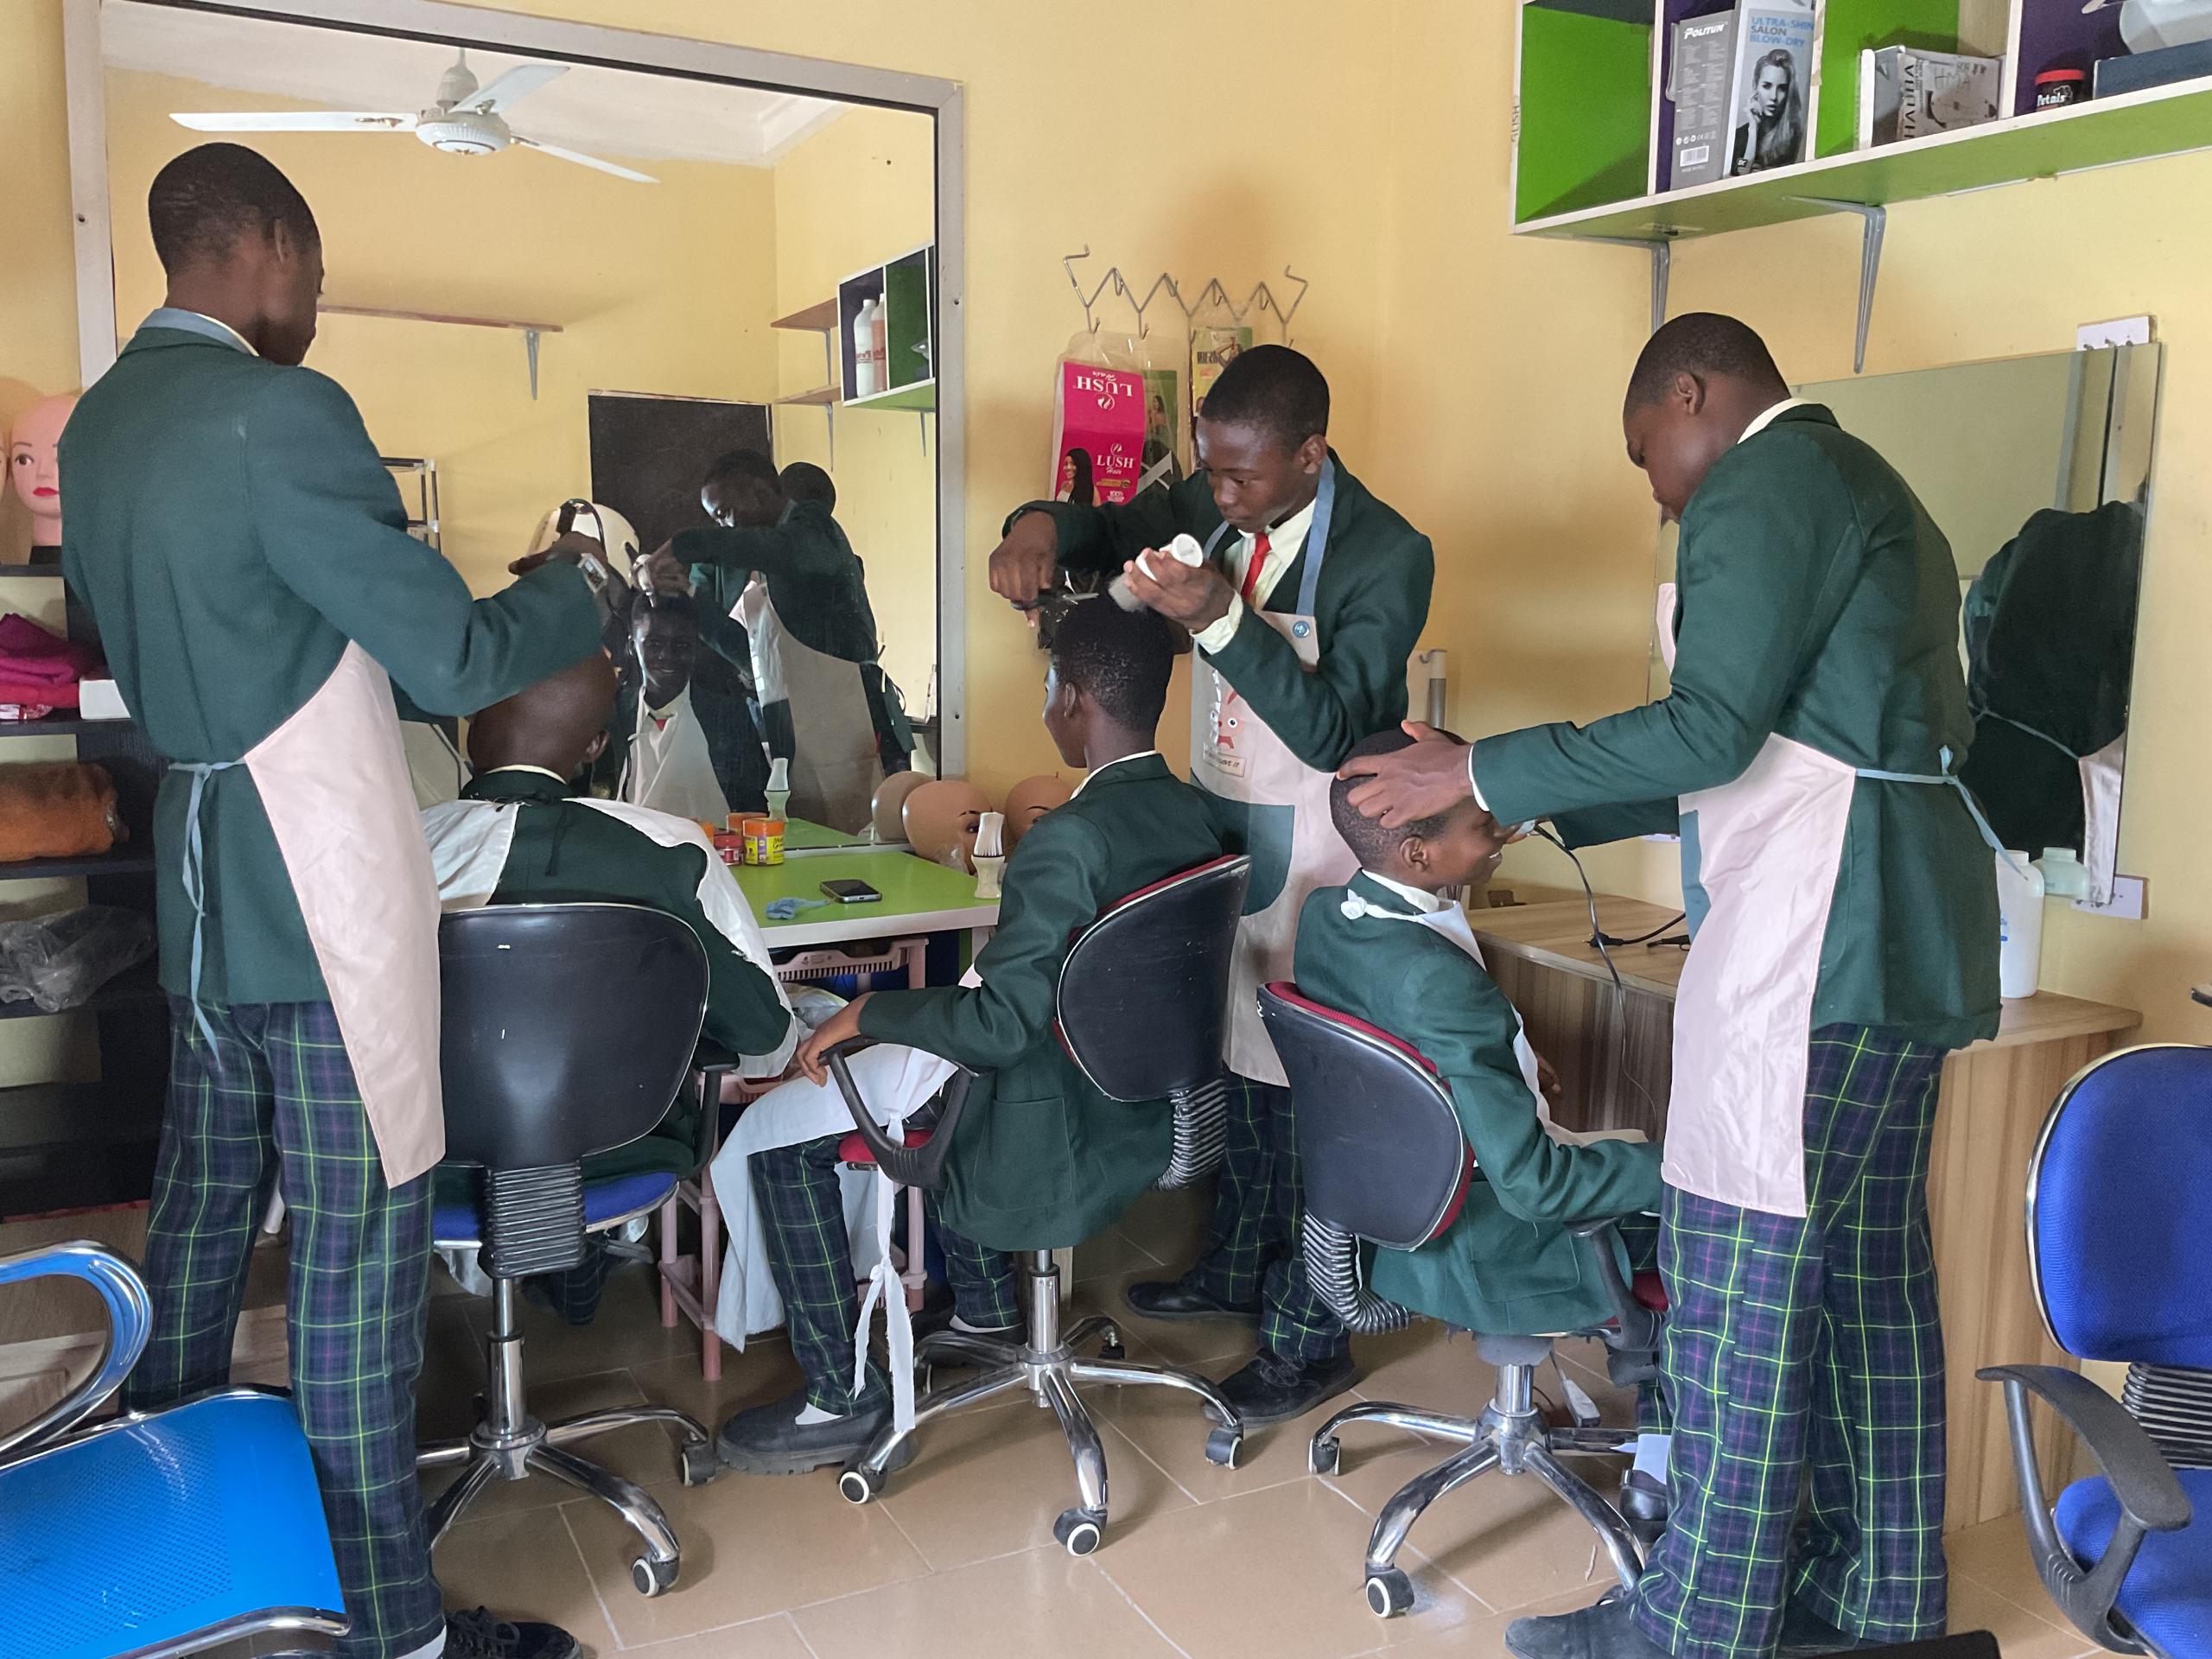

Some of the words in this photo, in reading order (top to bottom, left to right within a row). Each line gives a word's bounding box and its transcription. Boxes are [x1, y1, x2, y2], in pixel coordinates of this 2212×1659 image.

[1751, 16, 1814, 29] ULTRA-SHIN
[1751, 25, 1787, 36] SALON
[1750, 34, 1807, 47] BLOW-DRY
[1076, 375, 1133, 397] LUSH
[1096, 454, 1135, 469] LUSH
[1106, 467, 1122, 475] Hair
